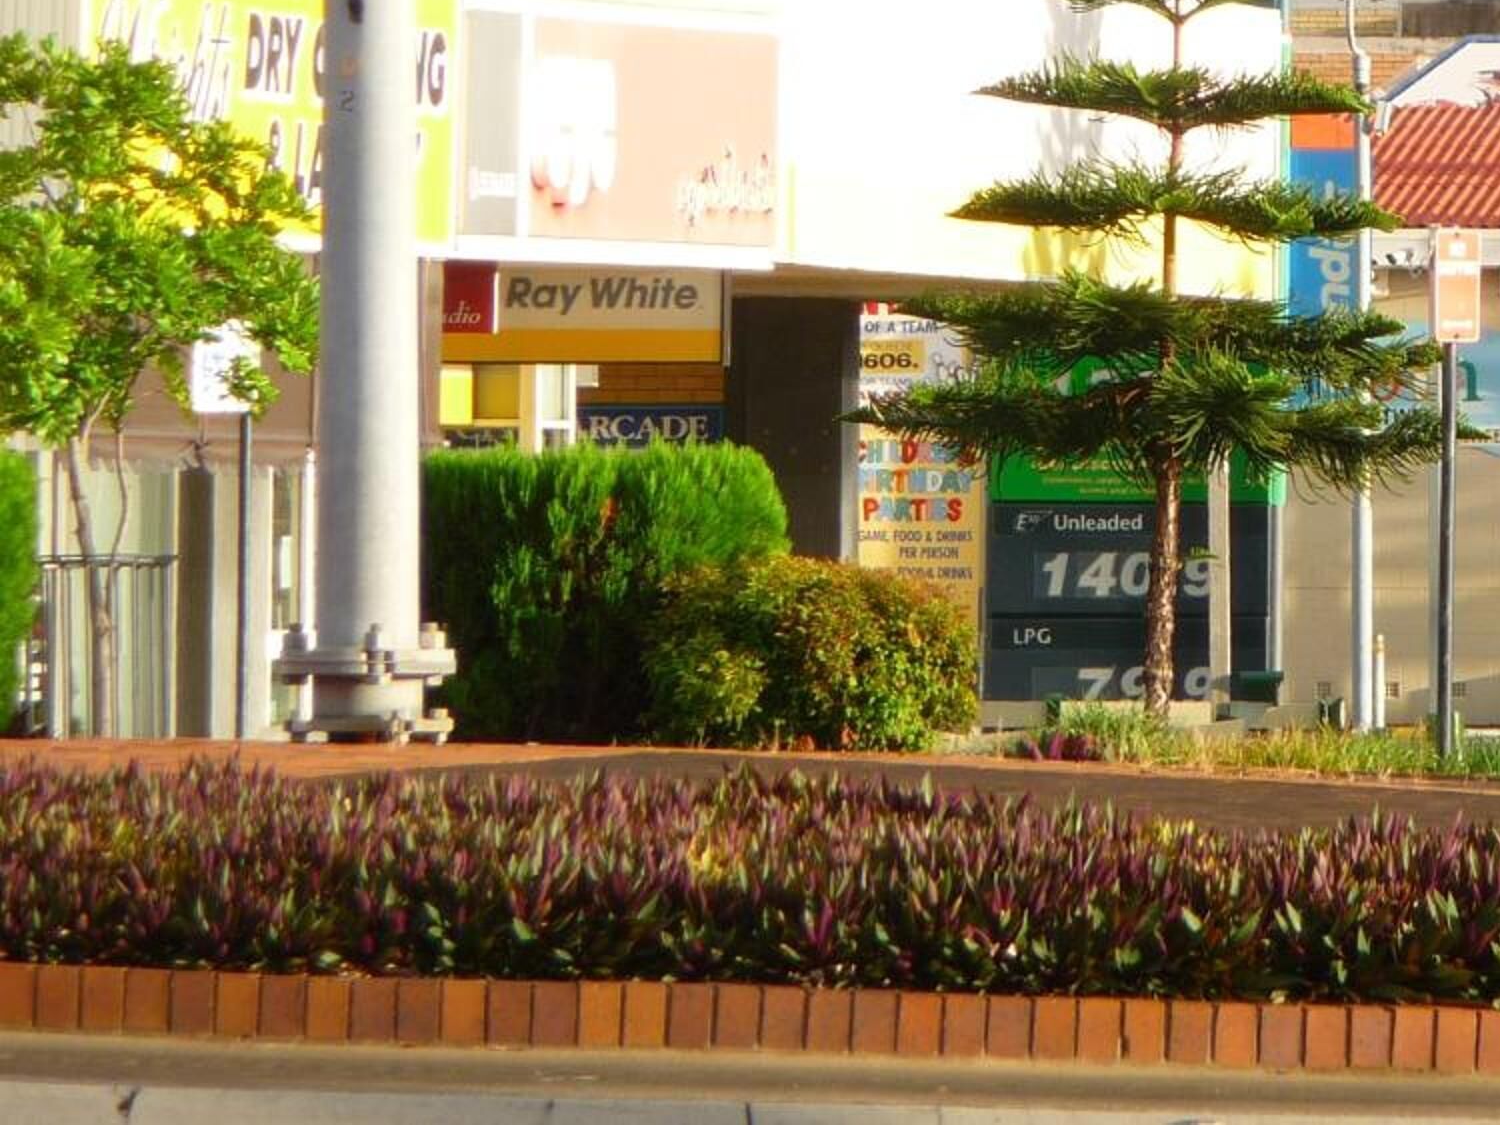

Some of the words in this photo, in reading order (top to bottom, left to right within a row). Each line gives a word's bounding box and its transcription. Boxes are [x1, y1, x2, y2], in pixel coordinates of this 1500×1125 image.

[244, 13, 303, 95] DRY
[505, 276, 582, 316] Ray
[590, 276, 699, 310] White
[583, 414, 708, 441] RCADE
[862, 496, 963, 522] PARTIES
[1054, 513, 1144, 531] Unleaded
[1013, 627, 1052, 645] LPG
